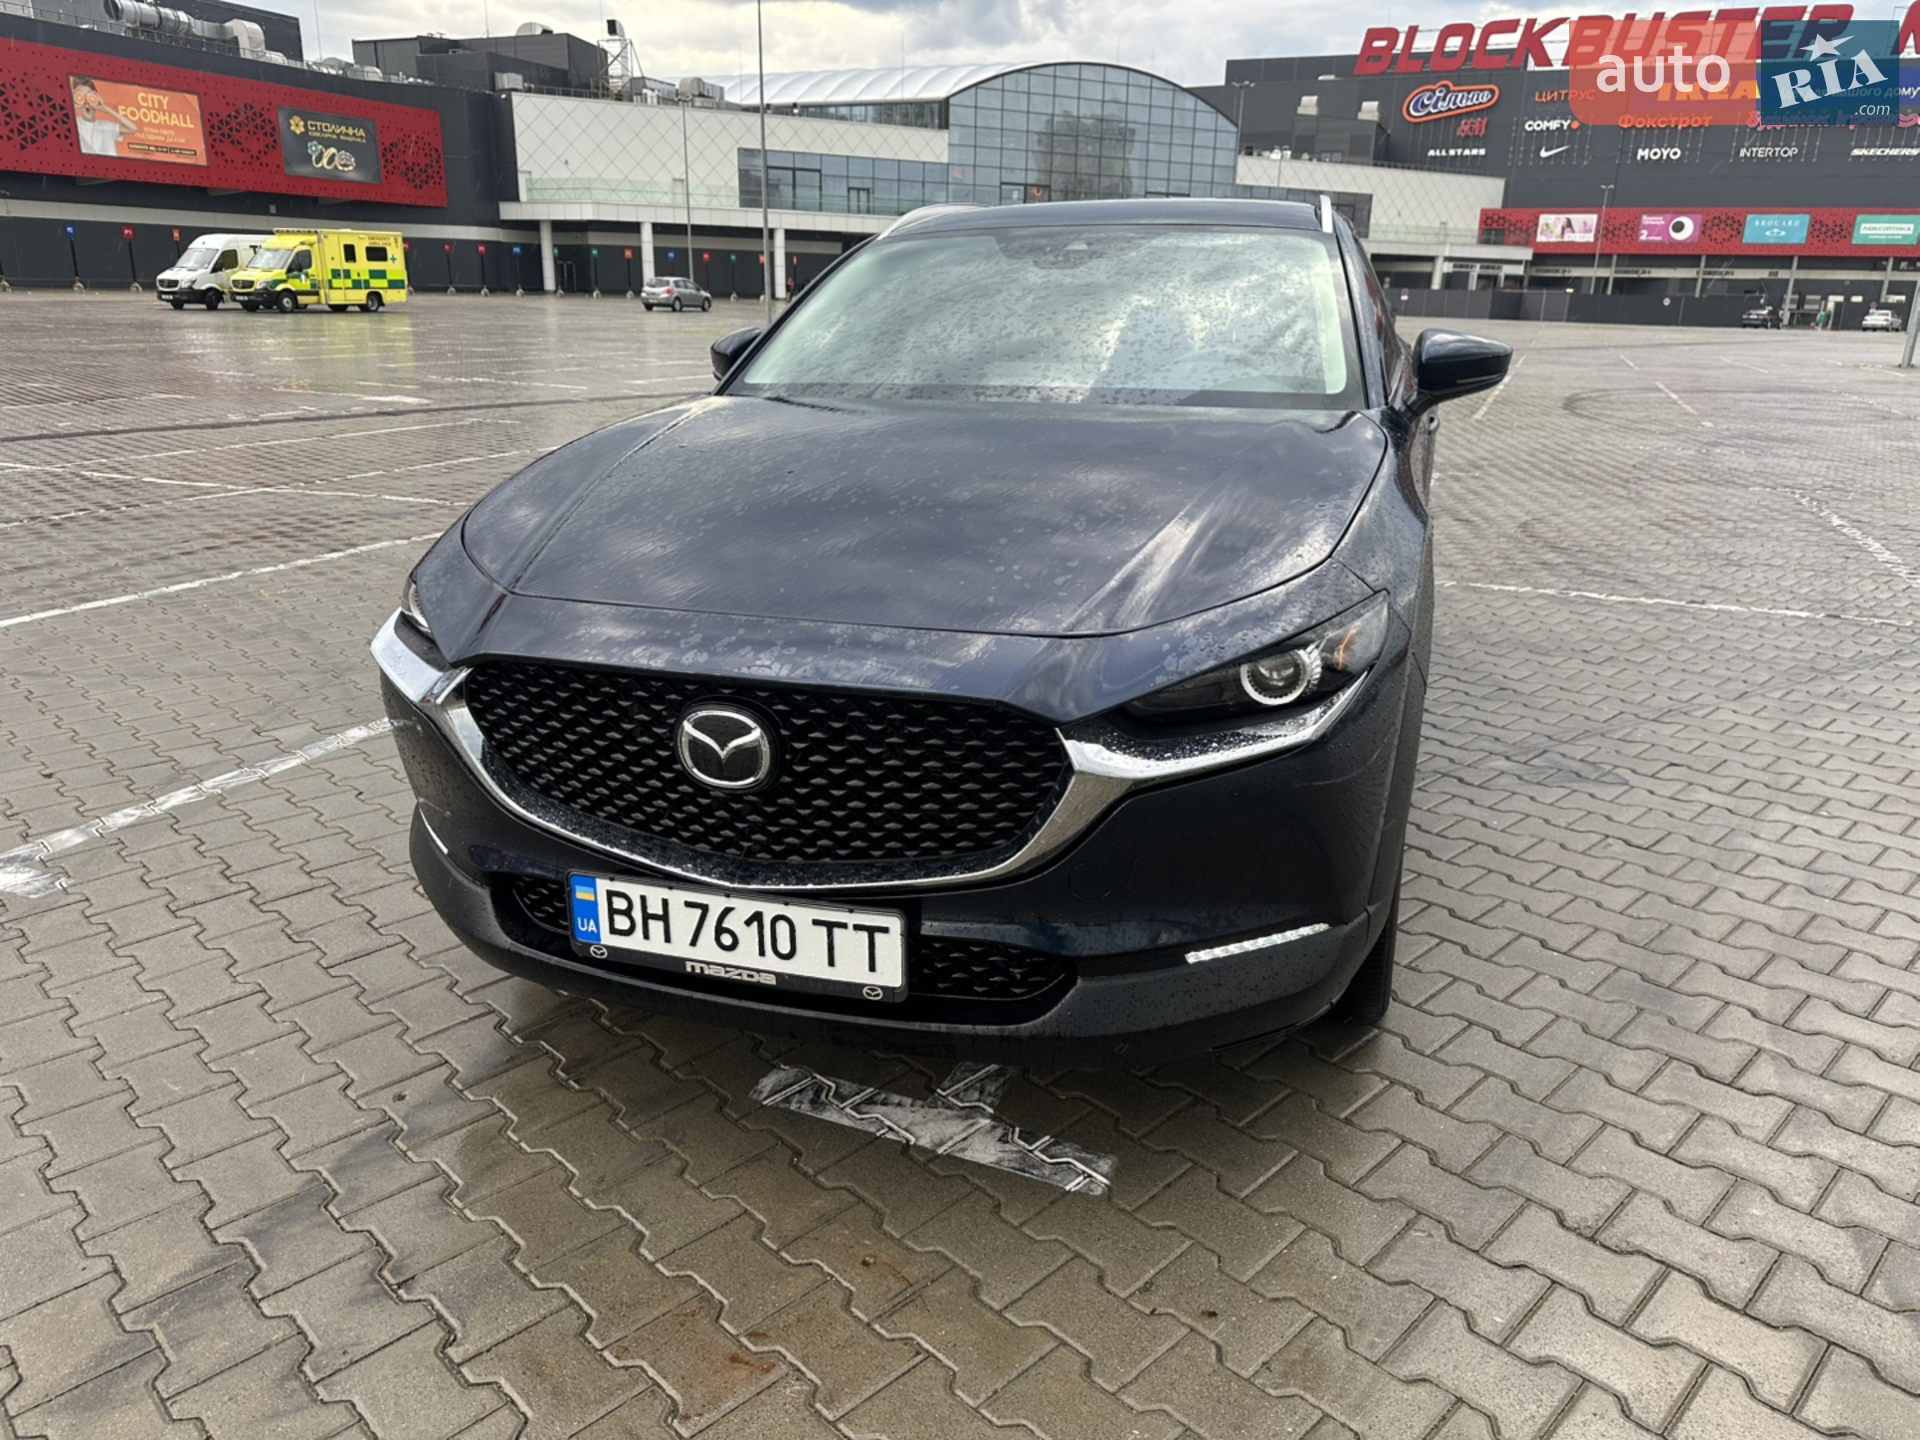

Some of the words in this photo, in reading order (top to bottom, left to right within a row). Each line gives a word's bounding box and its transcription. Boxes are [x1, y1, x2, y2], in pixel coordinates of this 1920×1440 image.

[1353, 4, 1854, 76] BLOCKBUSTER
[1535, 89, 1596, 103] ЦИТРУС
[1657, 79, 1761, 102] IKEA
[137, 92, 169, 110] CITY
[1409, 87, 1492, 116] Сільпо
[117, 105, 195, 129] FOODHALL
[1524, 119, 1571, 131] COMFY
[1618, 113, 1713, 130] Фокстрот
[307, 120, 366, 138] СТОЛИЧНА
[1637, 147, 1681, 160] MOYO
[1739, 147, 1798, 157] INTERTOP
[1850, 147, 1920, 156] SKECHERS
[1754, 219, 1801, 227] BROCARD
[577, 916, 598, 934] UA
[606, 889, 672, 944] BH
[684, 900, 797, 961] 7610
[811, 918, 890, 973] TT
[685, 961, 777, 986] mazda
